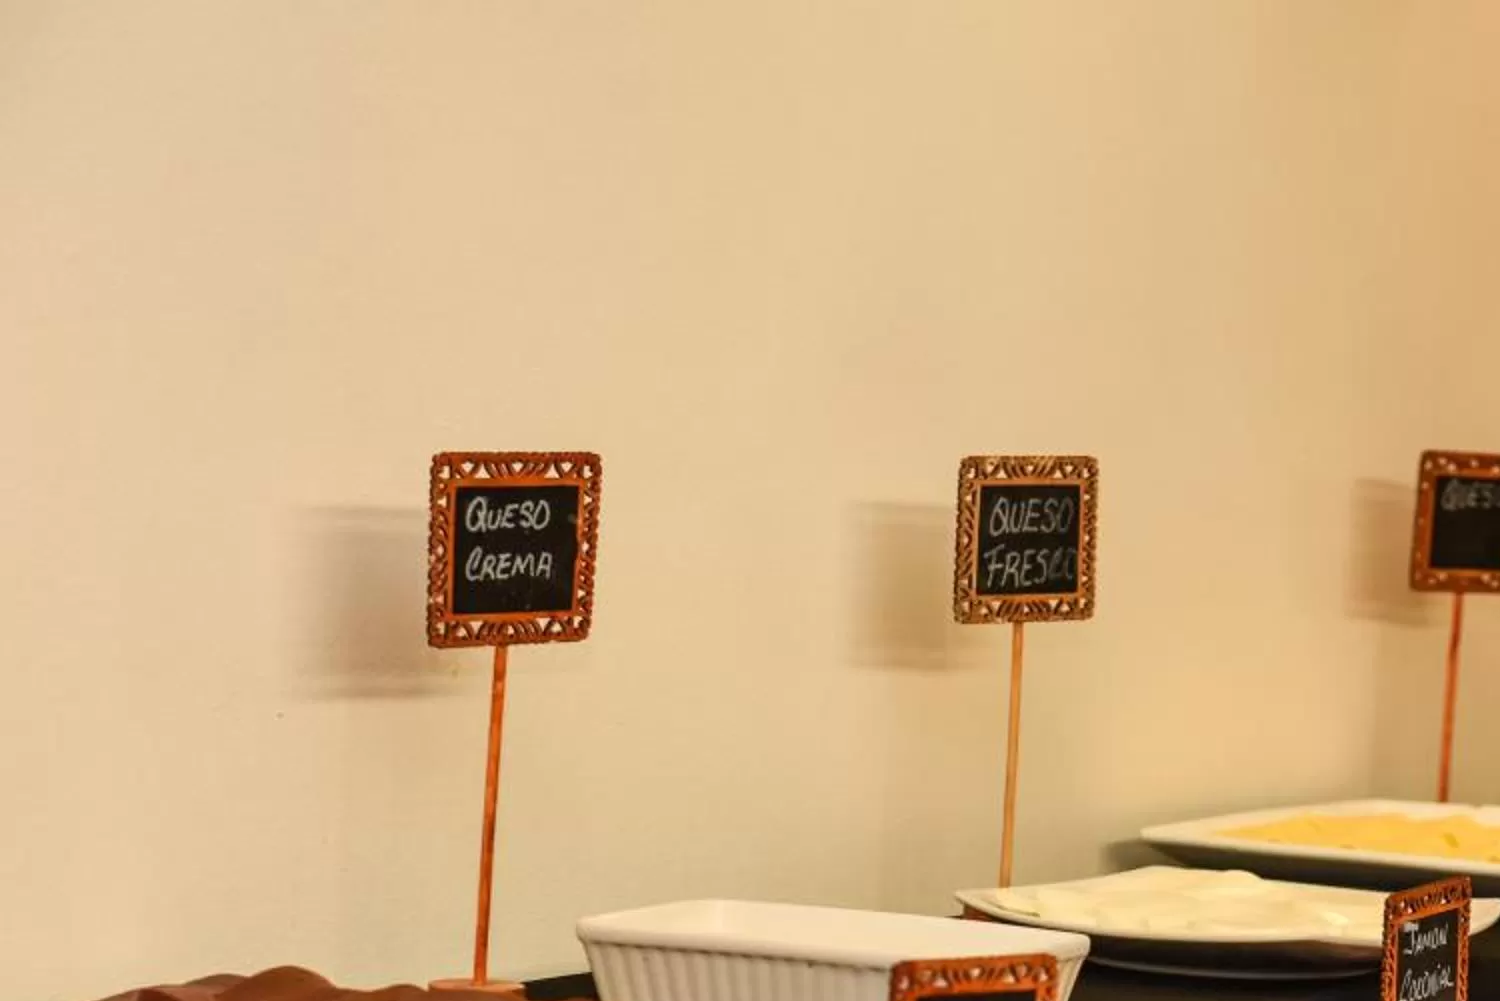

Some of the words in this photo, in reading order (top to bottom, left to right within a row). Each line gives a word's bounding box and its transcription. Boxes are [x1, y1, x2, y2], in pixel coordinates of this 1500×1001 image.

[465, 496, 551, 533] QUESO
[989, 496, 1074, 537] QUESO
[465, 546, 553, 581] CREMA
